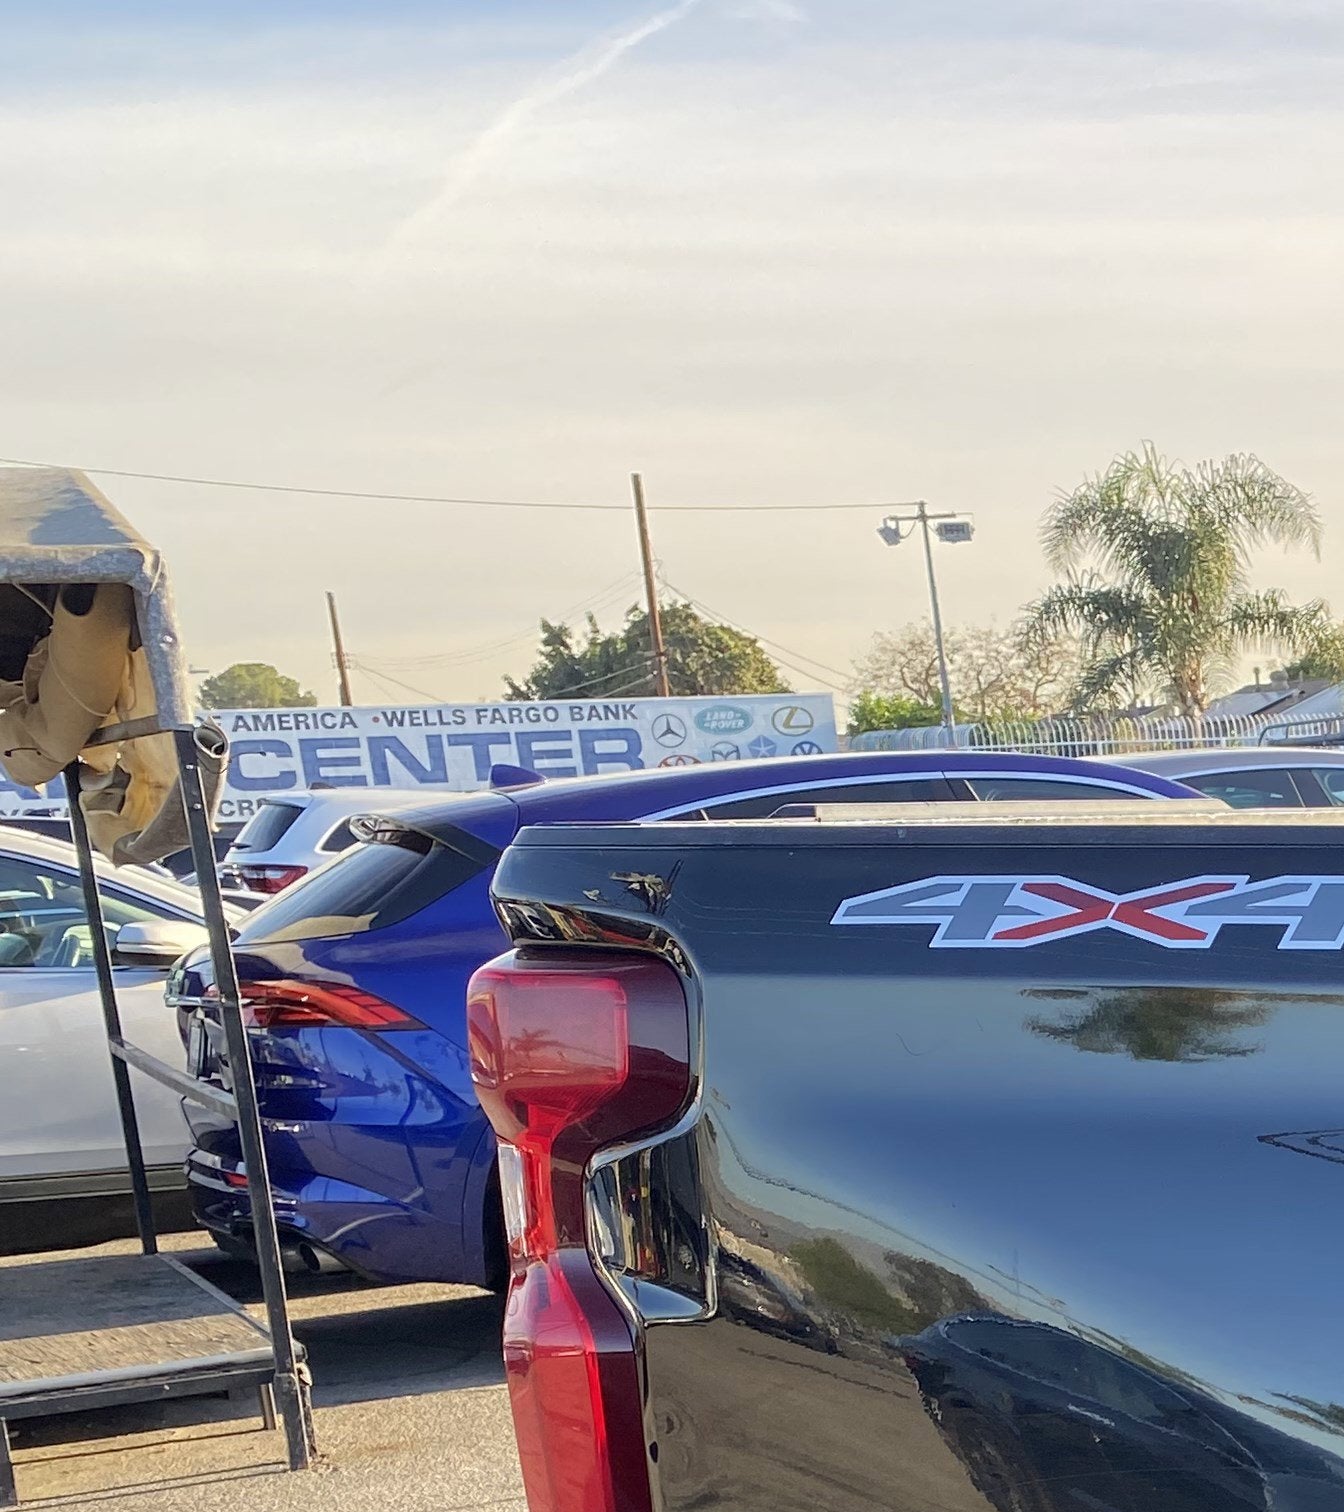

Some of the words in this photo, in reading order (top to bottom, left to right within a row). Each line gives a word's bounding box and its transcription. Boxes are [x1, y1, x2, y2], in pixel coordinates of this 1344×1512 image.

[231, 711, 359, 733] AMERICA
[382, 708, 466, 728] WELLS
[475, 704, 559, 725] FARGO
[569, 703, 639, 722] BANK
[227, 727, 645, 791] CENTER
